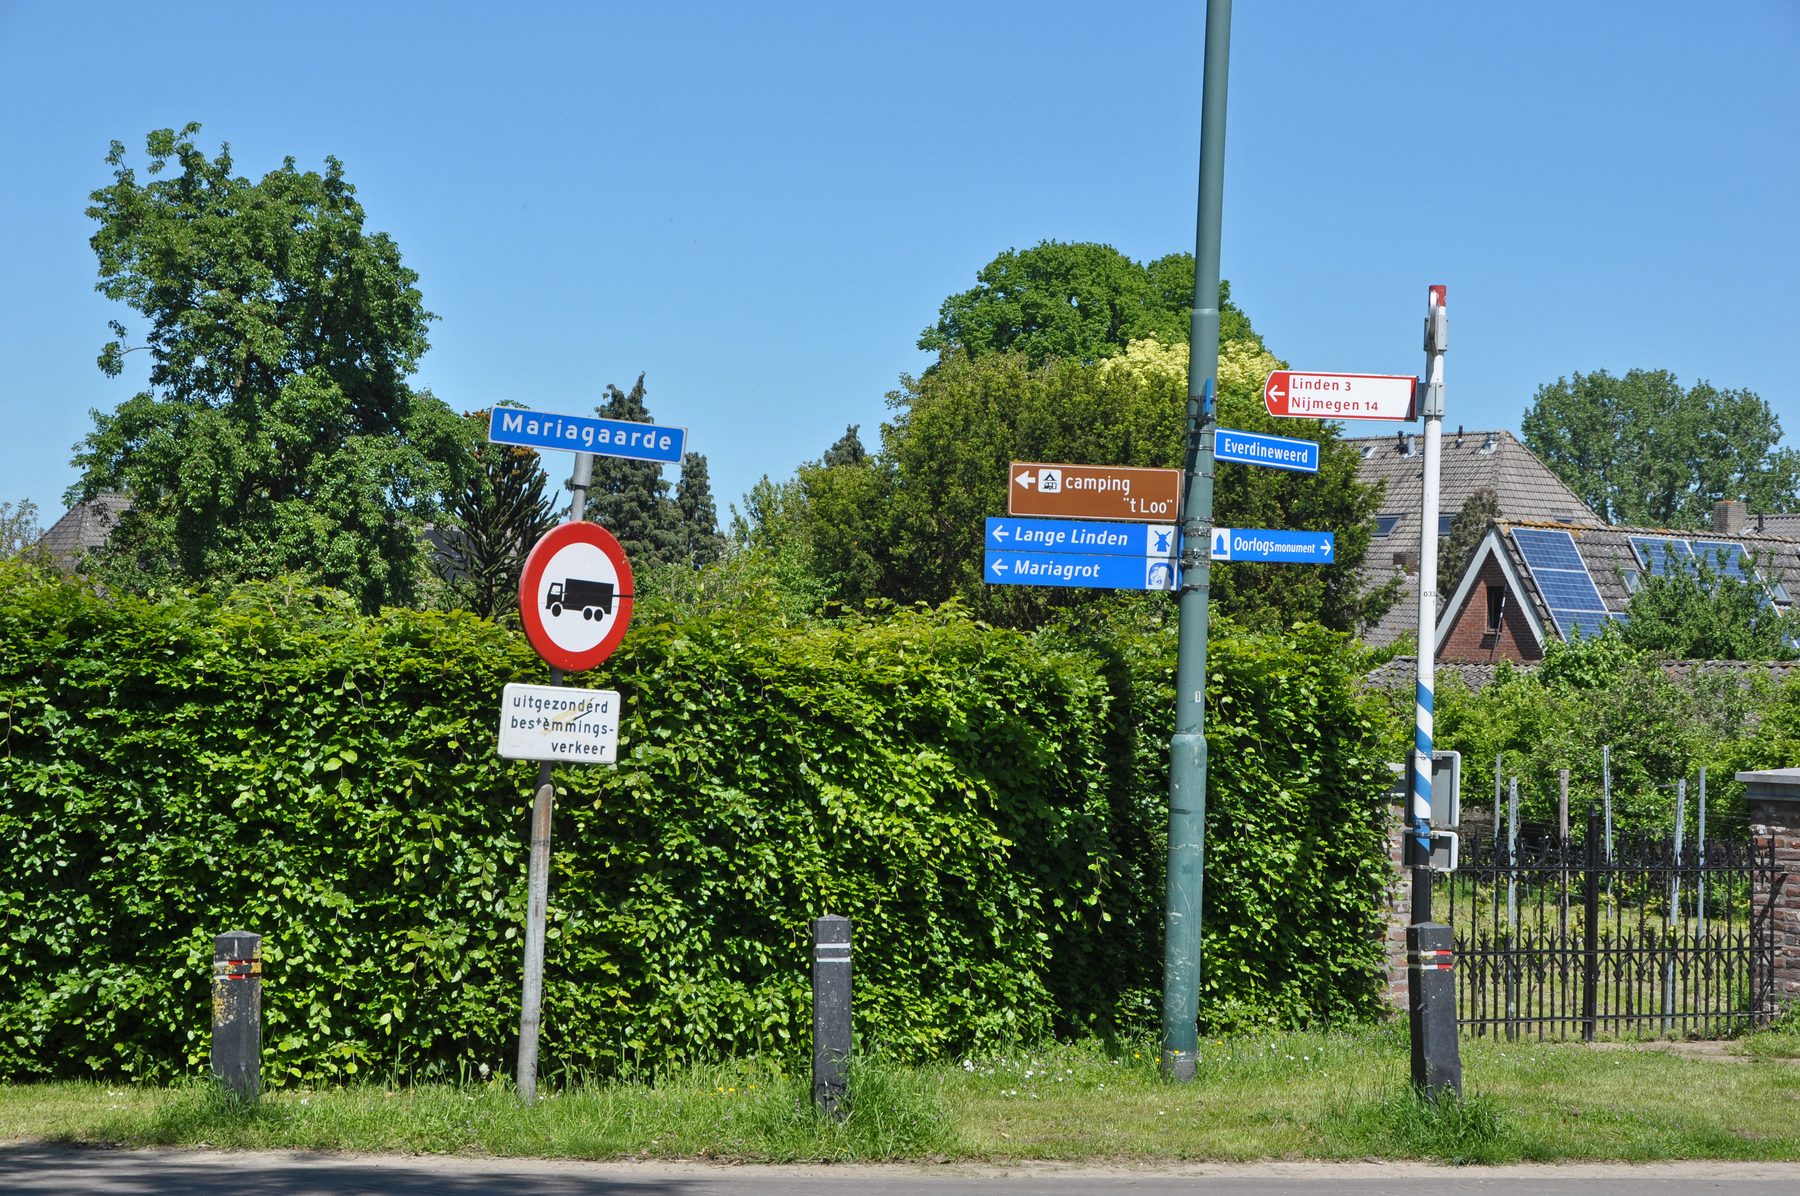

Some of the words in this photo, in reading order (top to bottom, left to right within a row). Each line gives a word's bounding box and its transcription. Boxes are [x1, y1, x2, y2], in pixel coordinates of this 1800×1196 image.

[1291, 378, 1340, 391] Linden
[1344, 381, 1352, 391] 3
[1291, 397, 1360, 412] Nijmegen
[1364, 401, 1379, 411] 14
[502, 413, 672, 450] Mariagaarde
[1224, 438, 1308, 463] Everdineweerd
[1065, 475, 1131, 496] camping
[1015, 526, 1066, 546] Lange
[1071, 529, 1128, 546] Linden
[1234, 536, 1316, 556] Oorlogsmonument
[1014, 559, 1101, 580] Mariagrot
[513, 695, 609, 714] uitgezonderd
[551, 740, 606, 755] verkeer
